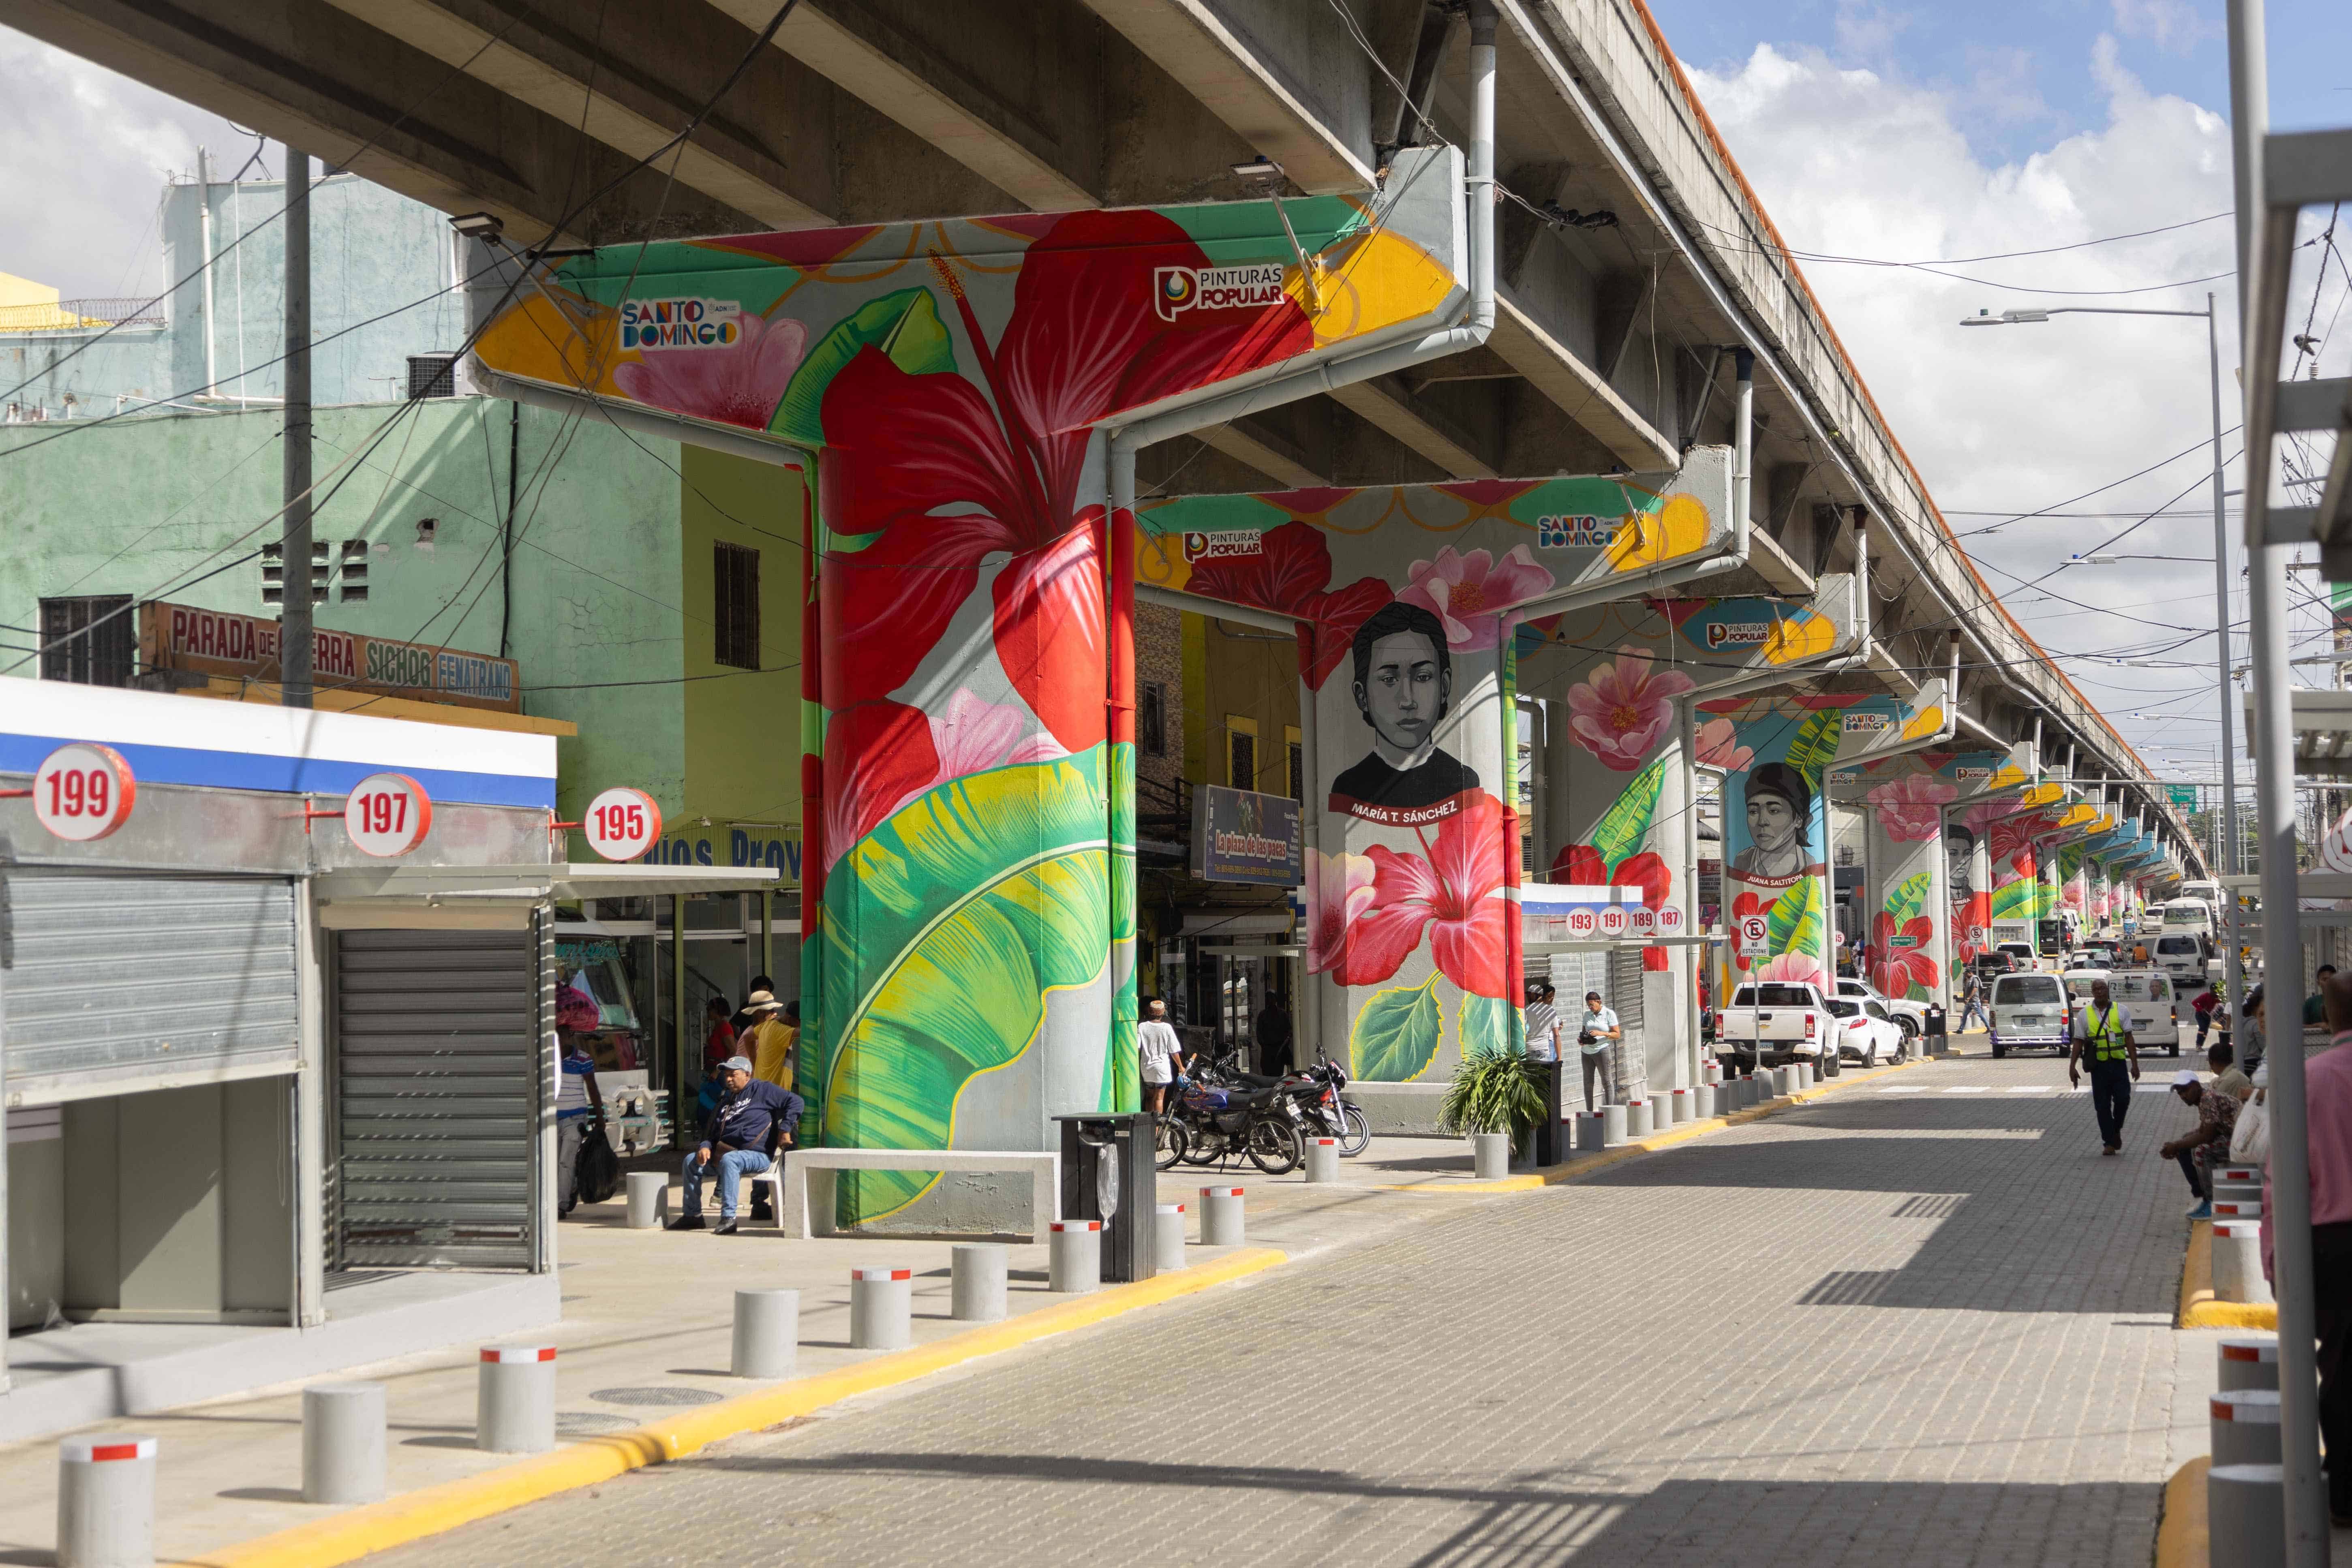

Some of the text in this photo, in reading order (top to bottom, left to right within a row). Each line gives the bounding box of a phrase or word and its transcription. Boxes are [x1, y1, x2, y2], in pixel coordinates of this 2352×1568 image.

[1201, 268, 1282, 287] PINTURAS
[1201, 285, 1281, 306] POPULAR
[623, 300, 704, 325] SANTO
[623, 322, 737, 348] DOMINGO
[1540, 516, 1597, 532] SANTO
[1211, 532, 1260, 543] PINTURAS
[1540, 531, 1620, 547] DOMINGO
[1211, 543, 1260, 555] POPULAR
[173, 610, 257, 661] PARADA
[259, 631, 276, 655] DE
[1729, 624, 1768, 632] PINTURAS
[1729, 632, 1768, 642] POPULAR
[438, 653, 511, 700] FENATRANO
[1845, 715, 1876, 723] SANTO
[1845, 721, 1888, 731] DOMINGO
[47, 769, 109, 817] 199
[358, 792, 408, 834] 197
[1351, 800, 1458, 823] MARÍA T. SÁNCHEZ
[594, 804, 644, 841] 195
[1216, 831, 1287, 861] La plaza de las pacas
[1747, 874, 1804, 886] JUANA SALTITOPA
[1570, 914, 1592, 930] 193
[1603, 913, 1622, 928] 191
[1633, 912, 1652, 927] 189
[1660, 911, 1678, 925] 187
